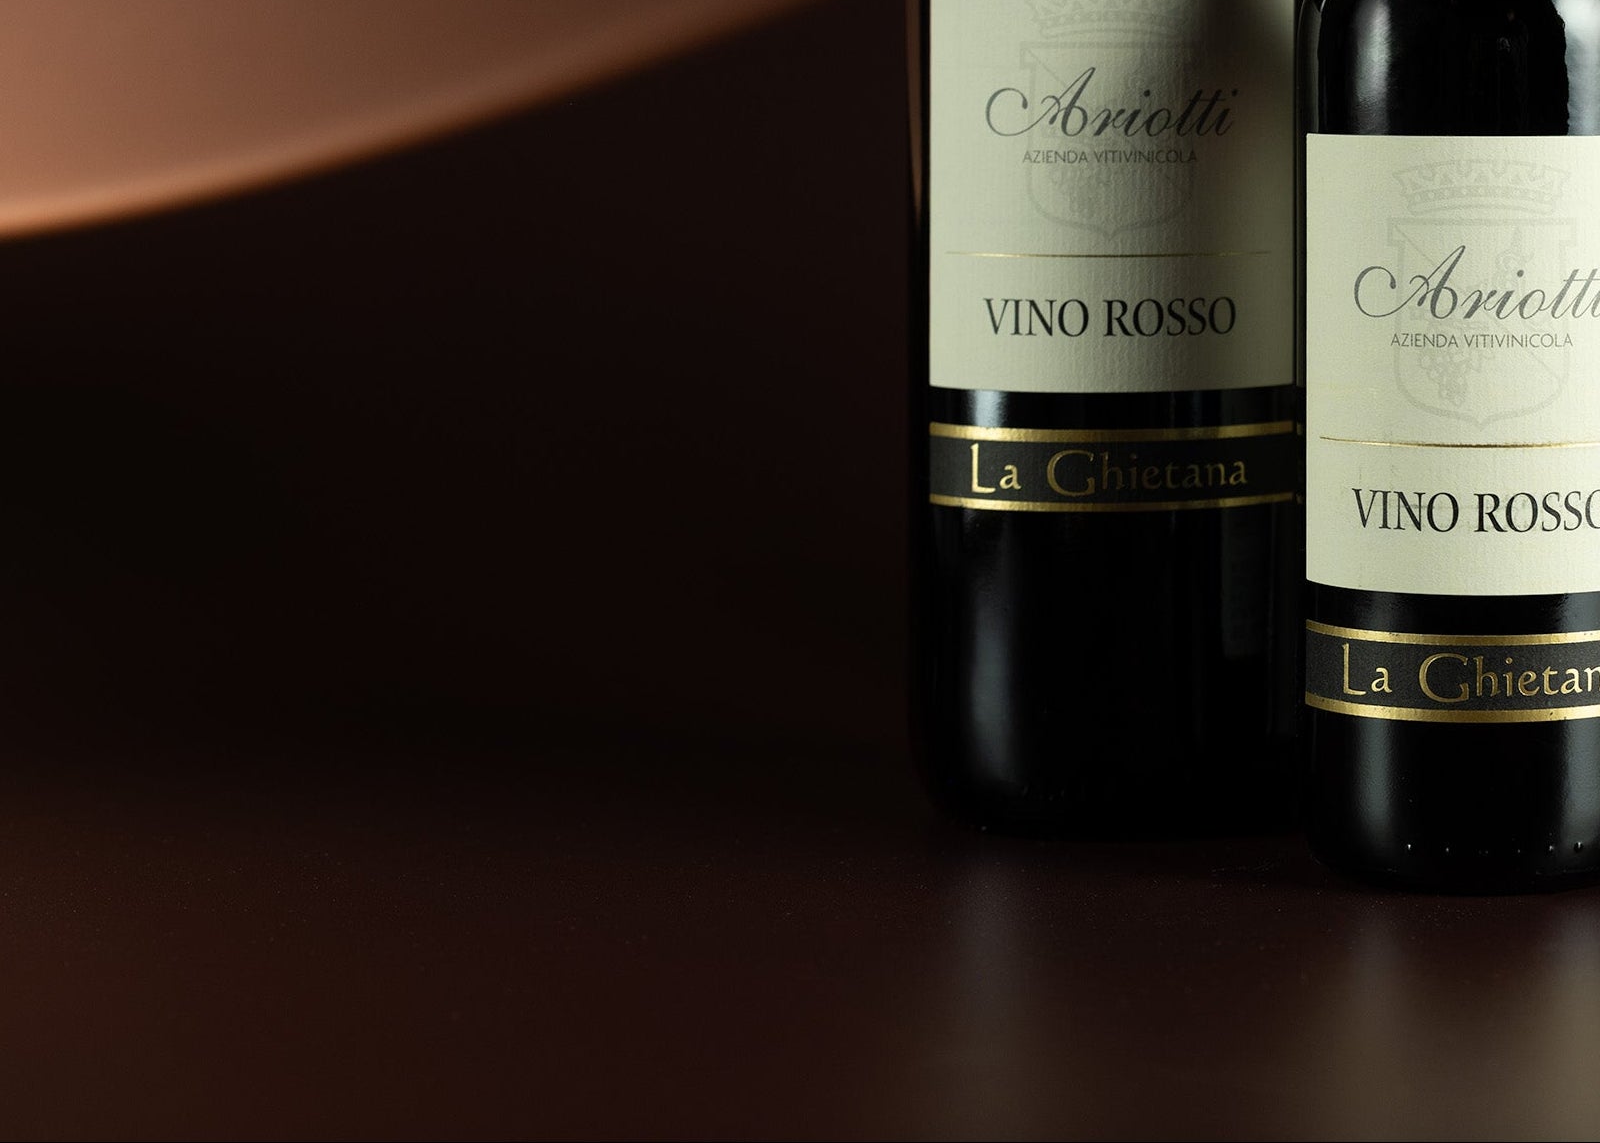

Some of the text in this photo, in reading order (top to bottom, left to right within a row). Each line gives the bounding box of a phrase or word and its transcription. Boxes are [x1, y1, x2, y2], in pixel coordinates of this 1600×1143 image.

[985, 67, 1238, 136] Ariotti
[1022, 149, 1197, 164] AZIENDA VITIVINICOLA
[983, 297, 1237, 337] VINO ROSSO
[1390, 332, 1573, 348] AZIENDA VITIVINICOLA
[971, 443, 1248, 497] La Ghietana
[1352, 488, 1459, 532] VINO
[1342, 643, 1392, 695] La
